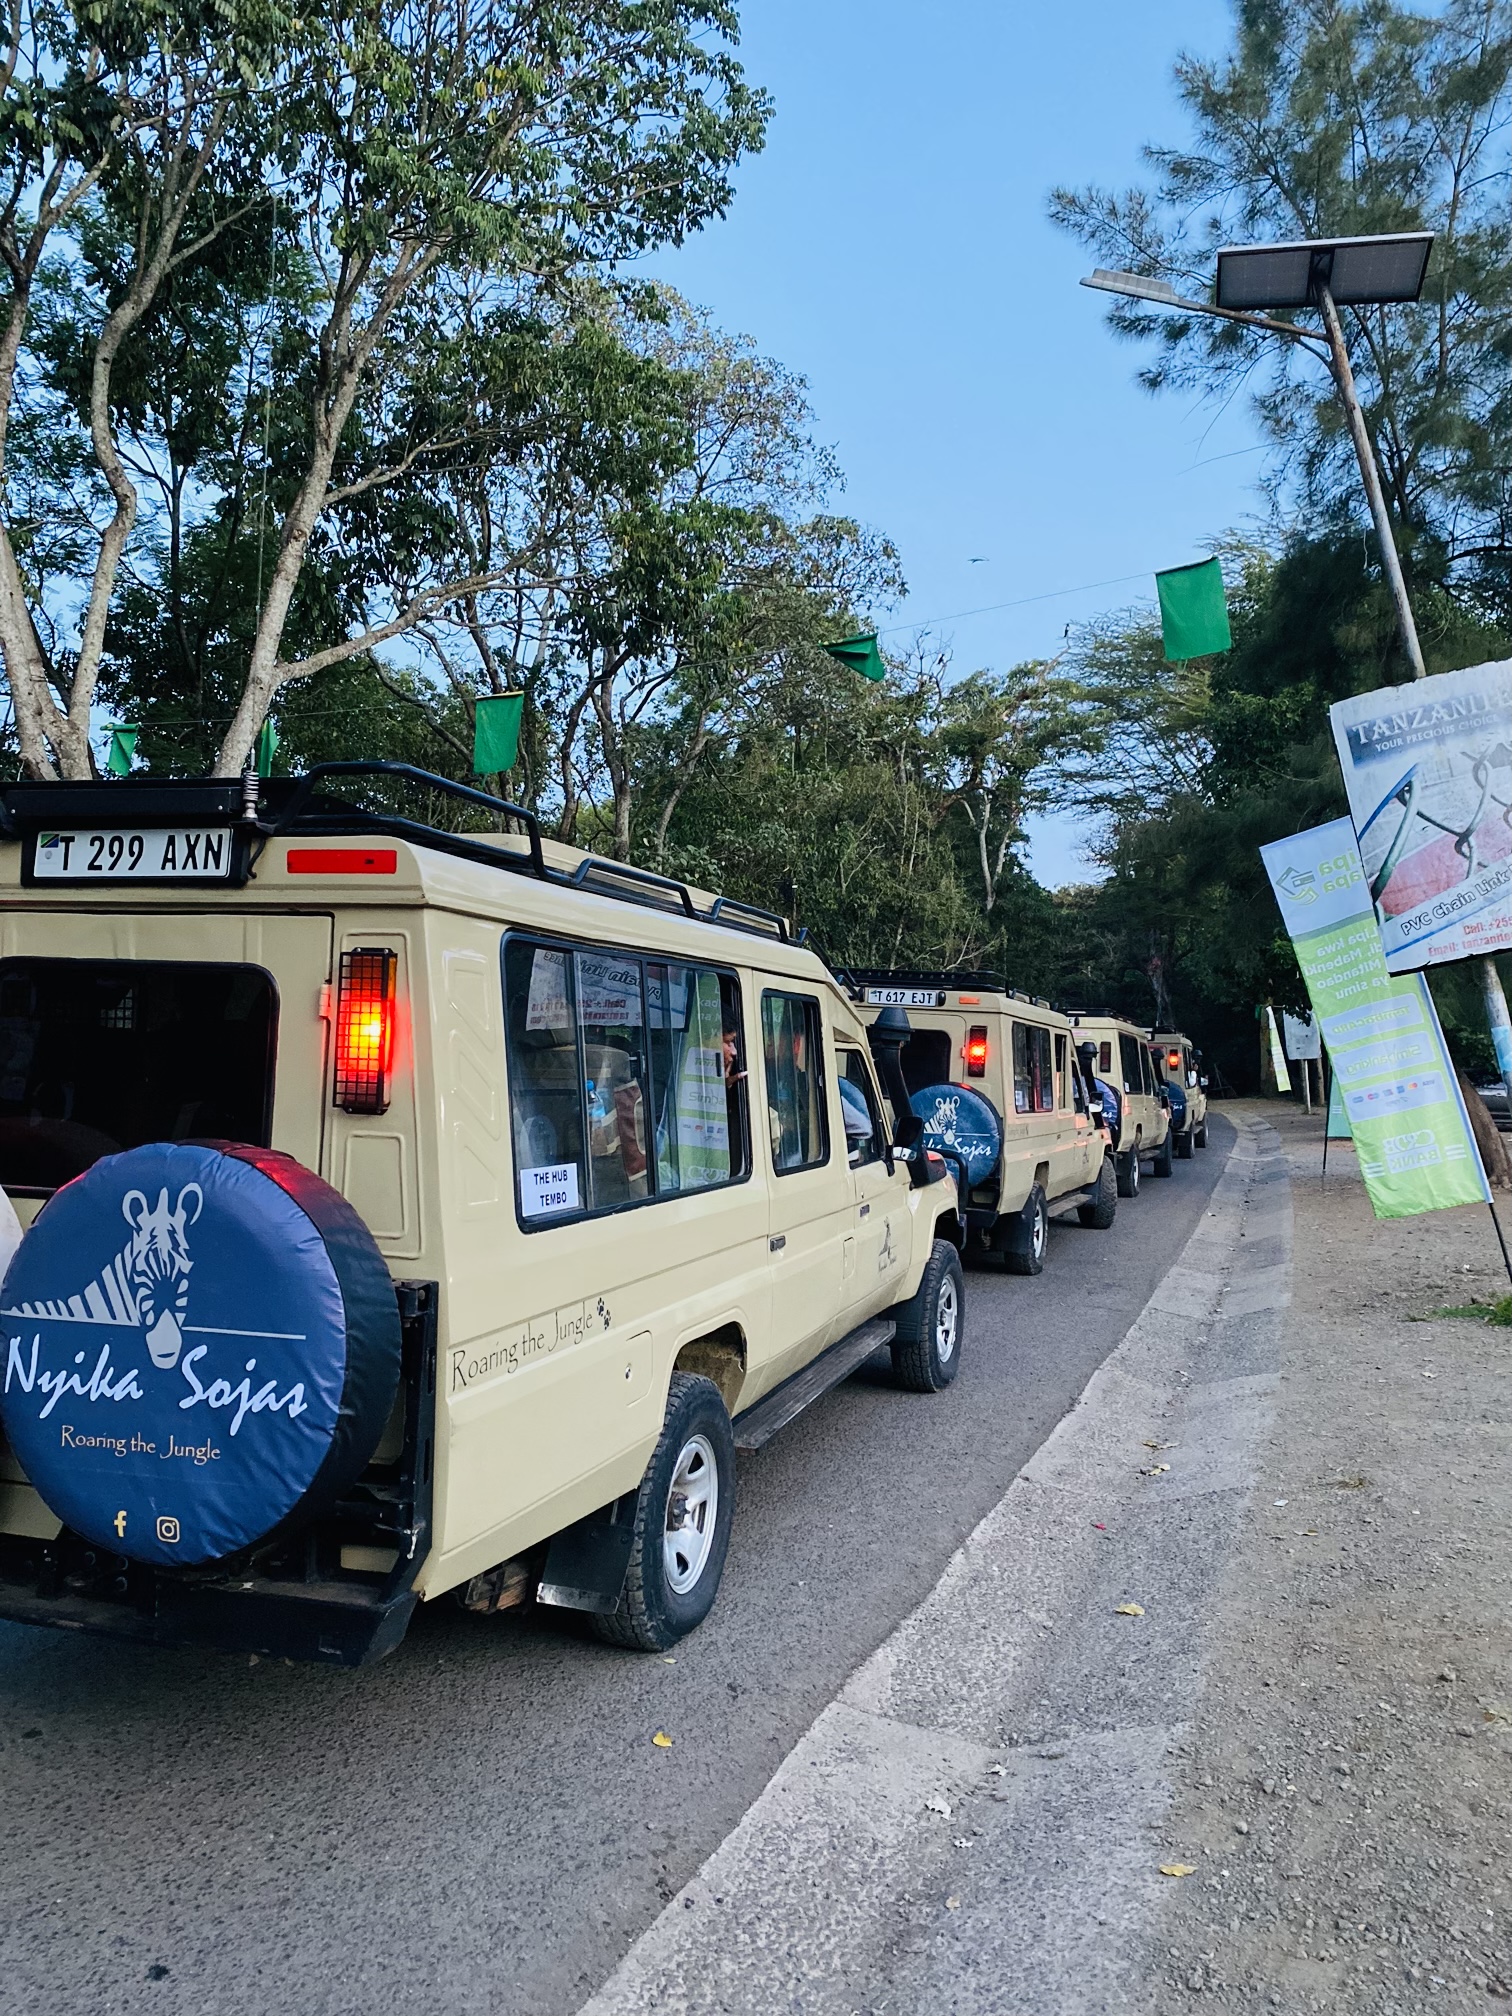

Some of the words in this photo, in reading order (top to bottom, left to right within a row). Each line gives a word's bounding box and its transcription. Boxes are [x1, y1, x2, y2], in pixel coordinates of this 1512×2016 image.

[1352, 694, 1494, 744] TANZANIT
[1375, 737, 1403, 752] YOUR
[1407, 725, 1455, 744] PRECIOUS
[1459, 713, 1498, 730] CHOICE
[60, 836, 75, 871] T
[87, 835, 144, 871] 299
[161, 834, 224, 871] AXN
[1400, 911, 1432, 936] PVC
[1432, 891, 1476, 919] Chain
[1475, 871, 1510, 896] Link
[1462, 932, 1512, 949] tanzanite
[876, 991, 883, 1001] T
[886, 992, 905, 1002] 617
[912, 993, 932, 1004] EJT
[954, 1138, 991, 1161] Sojas
[534, 1172, 549, 1186] THE
[552, 1170, 568, 1183] HUB
[540, 1191, 567, 1207] TEMBO
[452, 1339, 519, 1391] Roaring
[521, 1322, 545, 1355] the
[548, 1301, 592, 1352] Jungle
[4, 1333, 144, 1419] Nyika
[179, 1344, 308, 1437] Sojas
[61, 1425, 127, 1457] Roaring
[131, 1434, 156, 1454] the
[160, 1434, 221, 1465] Jungle
